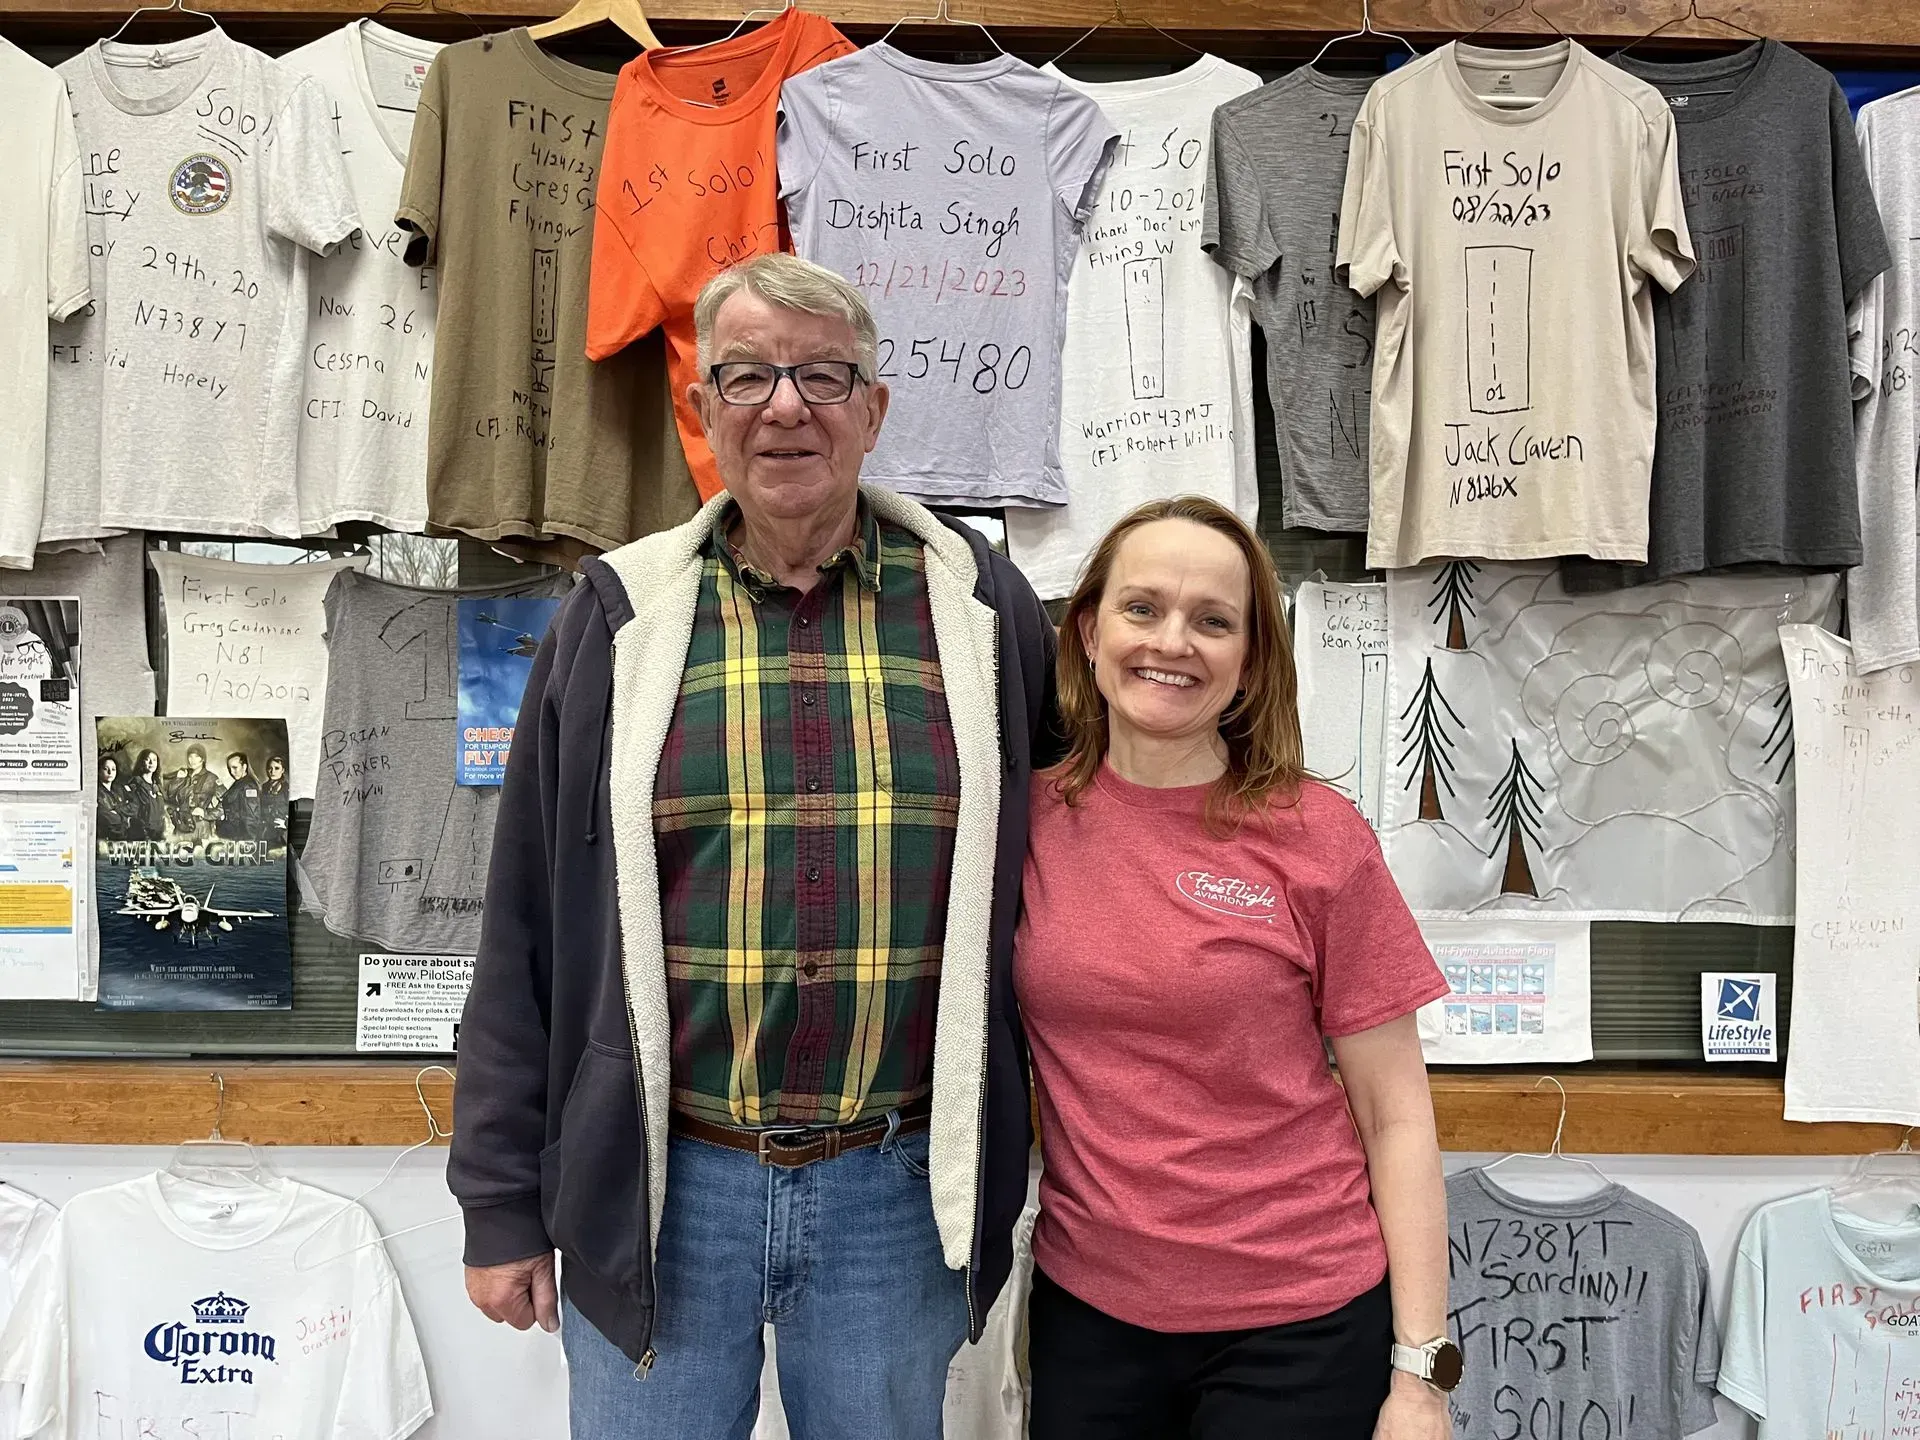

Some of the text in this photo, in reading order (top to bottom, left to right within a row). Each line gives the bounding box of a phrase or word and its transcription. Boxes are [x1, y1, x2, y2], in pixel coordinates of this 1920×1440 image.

[507, 100, 600, 148] First
[530, 141, 594, 183] 4/24/23
[850, 140, 1016, 177] First Solo
[1443, 149, 1562, 192] First Solo
[512, 162, 570, 205] Greg
[622, 163, 669, 216] 1st
[1451, 189, 1551, 229] 08/22/23
[825, 199, 1021, 258] Dishita Singh
[90, 239, 116, 258] ay
[142, 246, 217, 287] 29th,
[1088, 239, 1174, 270] Flying W
[855, 259, 1027, 304] 12/21/2023
[51, 345, 94, 363] FI:
[313, 343, 386, 375] Cessna
[877, 337, 1032, 394] 25480
[1485, 383, 1507, 402] 01
[361, 399, 412, 429] David
[1081, 410, 1152, 440] Warrior
[1126, 434, 1179, 454] Robert
[1444, 422, 1585, 468] Jack Craven
[182, 575, 287, 608] First Solo
[1322, 589, 1372, 612] First
[183, 612, 224, 637] Greg
[1321, 632, 1352, 649] Sean
[1801, 647, 1856, 677] First
[196, 669, 310, 703] 9/20/2012
[320, 726, 391, 766] BRIAN
[464, 743, 480, 751] FOR
[464, 750, 496, 765] FLY
[326, 754, 392, 786] PARKER
[464, 772, 476, 780] For
[106, 840, 275, 868] WING GIRL
[1193, 889, 1244, 907] AVIATION
[364, 956, 380, 966] Do
[382, 958, 402, 968] you
[404, 958, 428, 967] care
[430, 957, 461, 967] about
[387, 969, 473, 981] www.PilotSafe
[436, 982, 464, 990] Experts
[385, 1015, 410, 1023] product
[425, 1007, 443, 1015] pilots
[383, 1033, 408, 1041] training
[388, 1024, 404, 1032] topic
[405, 1024, 432, 1032] sections
[1707, 1024, 1772, 1044] LifeStyle
[1447, 1218, 1634, 1280] N738YT
[1799, 1282, 1883, 1315] FIRST
[143, 1321, 277, 1367] Corona
[180, 1359, 254, 1385] Extra
